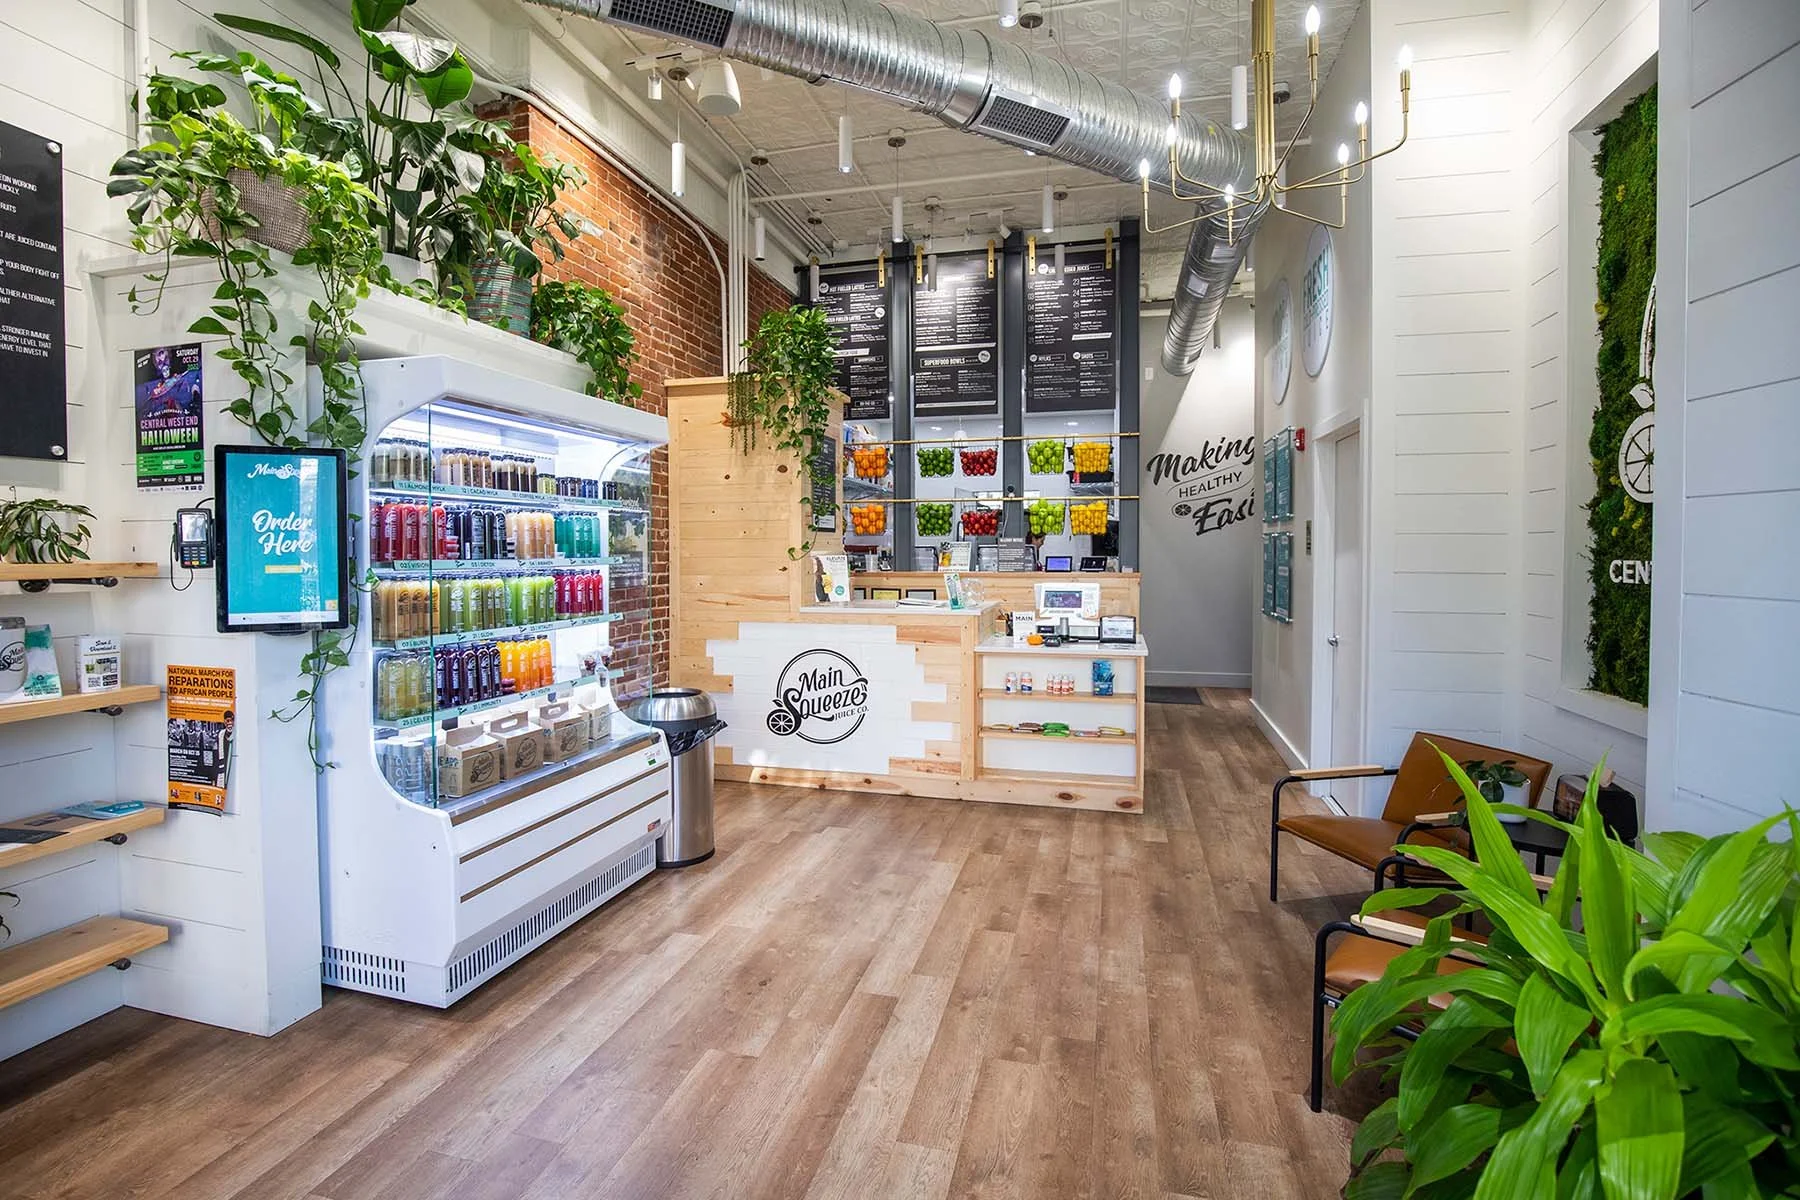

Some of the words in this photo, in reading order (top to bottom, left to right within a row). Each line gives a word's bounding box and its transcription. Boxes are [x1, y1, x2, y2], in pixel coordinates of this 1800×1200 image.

[12, 178, 37, 192] WORKING
[5, 232, 16, 241] ARE
[18, 236, 34, 246] JUICED
[35, 241, 57, 252] CONTAIN
[6, 260, 19, 270] YOUR
[20, 264, 35, 273] BODY
[35, 268, 50, 277] FIGHT
[22, 292, 56, 306] ALTERNATIVE
[2, 325, 31, 336] STRONGER
[31, 331, 51, 340] IMMUNE
[21, 338, 37, 348] LEVEL
[24, 348, 41, 356] INVEST
[176, 349, 199, 357] SATURDAY
[141, 418, 167, 429] CENTRAL
[168, 417, 184, 427] WEST
[186, 416, 199, 425] END
[141, 427, 199, 446] HALLOWEEN
[1147, 436, 1255, 486] Making
[1179, 472, 1242, 498] HEALTHY
[1192, 488, 1255, 536] Easi
[253, 510, 313, 532] Order
[258, 532, 314, 556] Here
[169, 676, 233, 689] REPARATIONS
[798, 667, 846, 693] Main
[179, 688, 207, 696] AFRICAN
[208, 689, 233, 698] PEOPLE
[481, 699, 502, 709] IMMUNITY
[783, 684, 868, 735] Squeeze
[835, 709, 856, 720] JUICE
[857, 706, 869, 714] CO.
